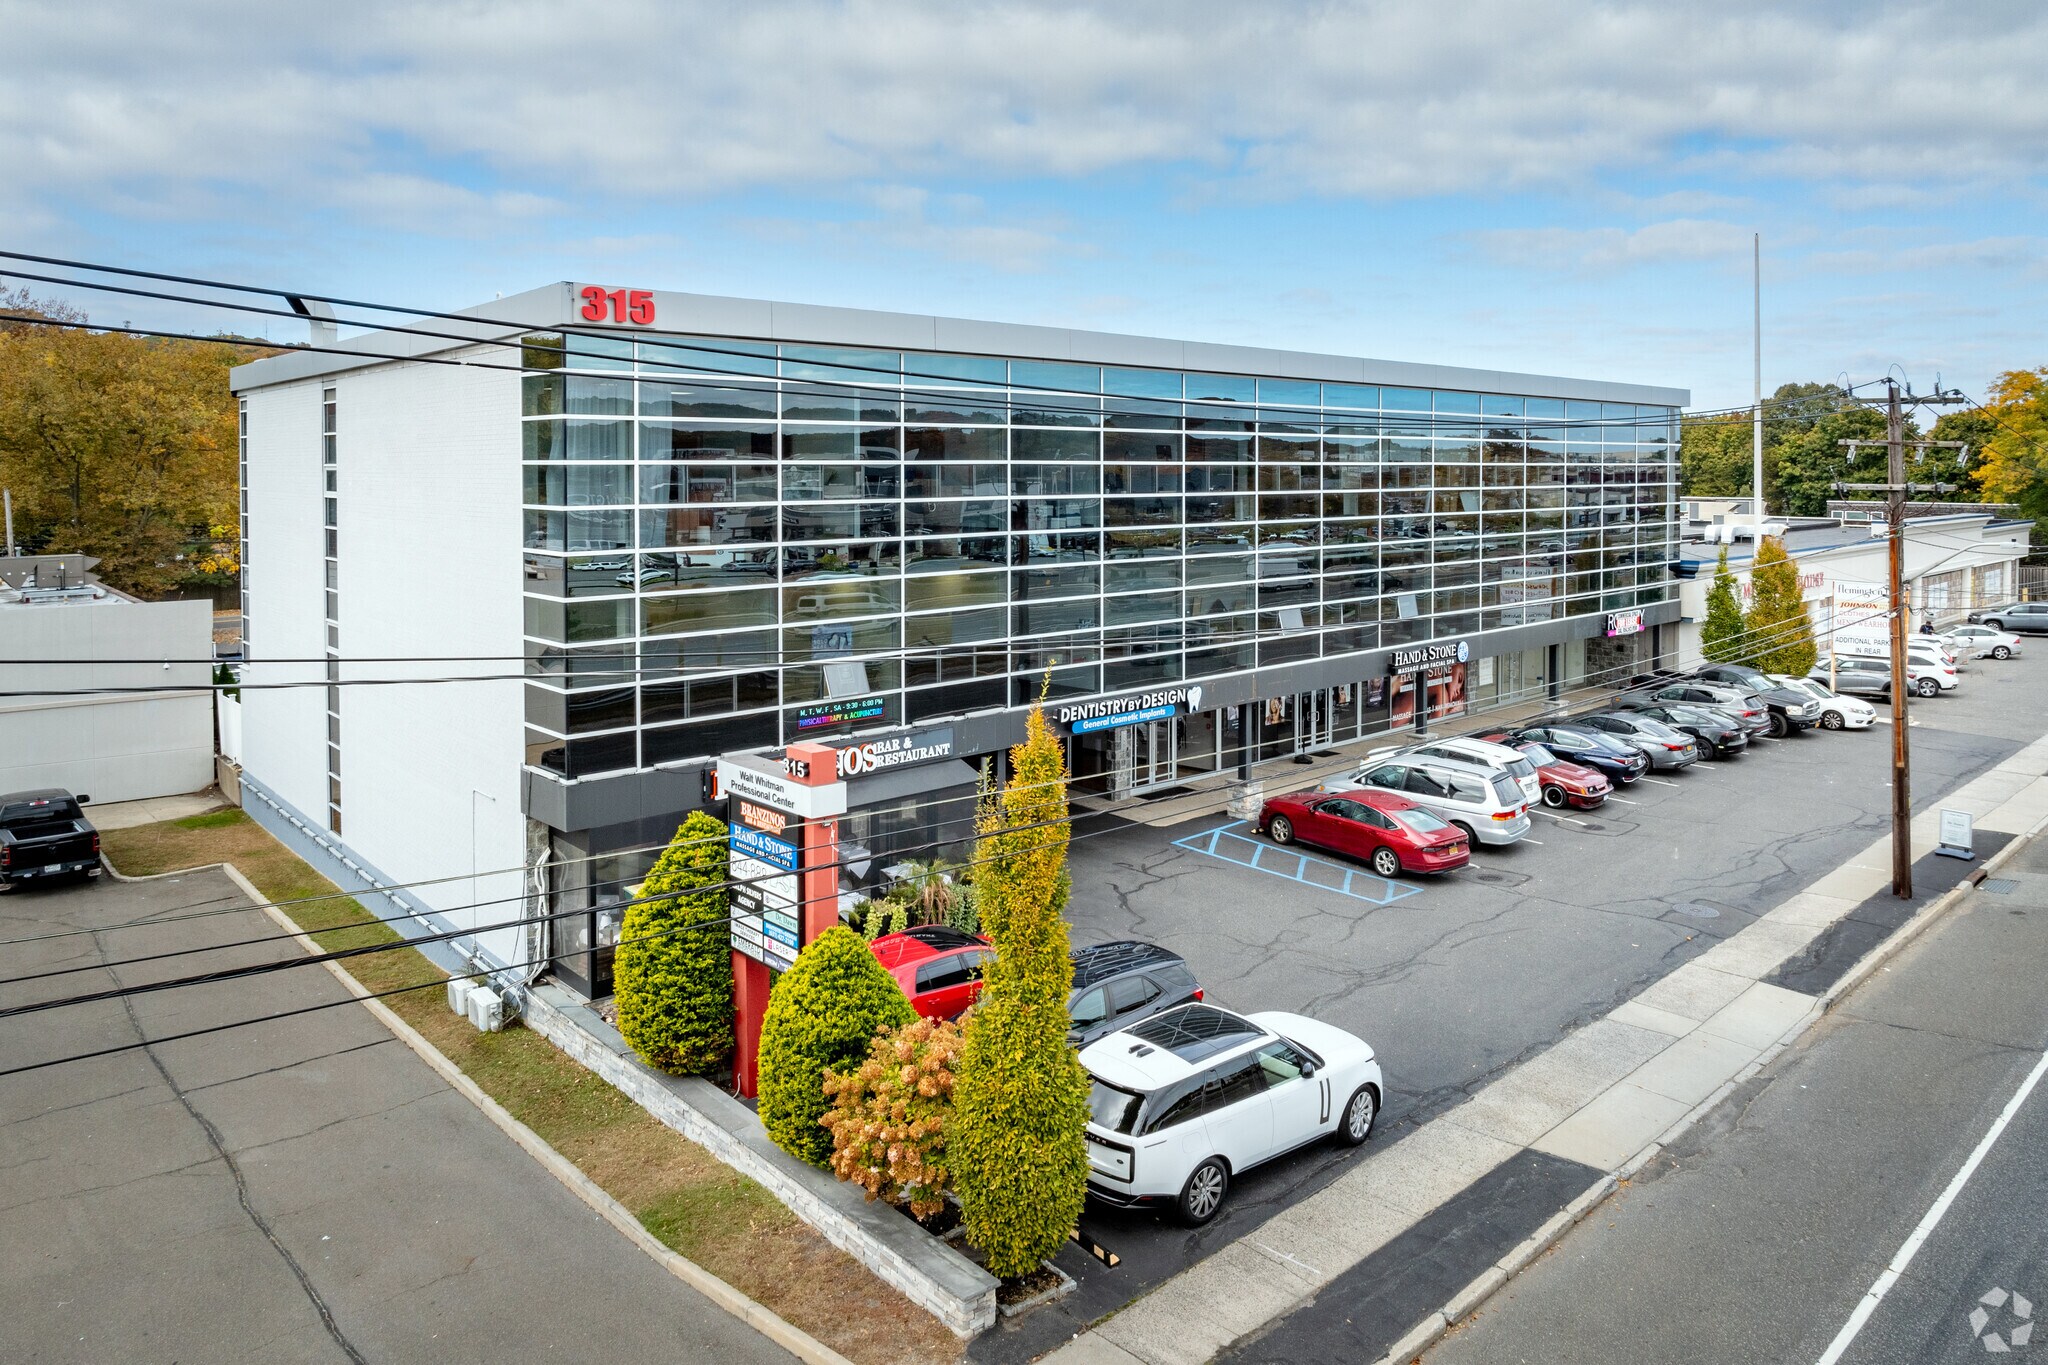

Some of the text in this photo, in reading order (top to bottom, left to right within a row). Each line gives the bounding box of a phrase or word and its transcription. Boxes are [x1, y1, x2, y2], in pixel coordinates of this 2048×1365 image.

[581, 286, 655, 324] 315
[1835, 636, 1871, 645] ADDITIONAL
[1394, 644, 1457, 667] HAND & STONE
[1397, 665, 1419, 675] MASSAGE
[874, 698, 883, 706] PM
[1060, 689, 1186, 723] DENTISTRY BY DESIGN
[1082, 708, 1166, 730] General Cosmetic Implants
[876, 737, 913, 754] BAR &
[877, 743, 951, 768] RESTAURANT
[783, 758, 806, 778] 315
[739, 770, 785, 793] Walt Whitman
[731, 779, 795, 809] Professional Center
[741, 801, 786, 829] BRANZINOS
[734, 825, 793, 860] HAND & STONE
[737, 894, 756, 910] AGENCY
